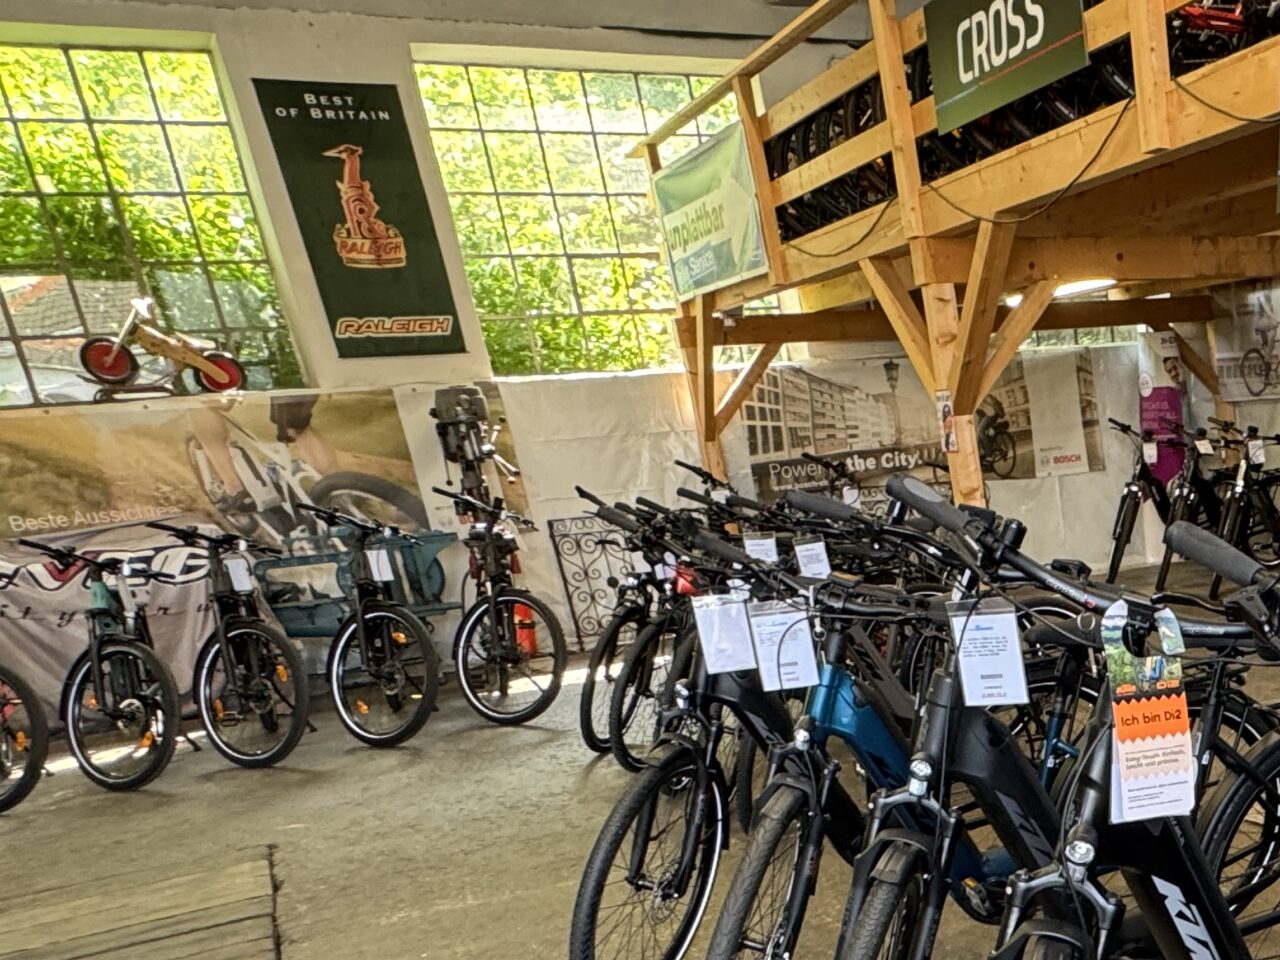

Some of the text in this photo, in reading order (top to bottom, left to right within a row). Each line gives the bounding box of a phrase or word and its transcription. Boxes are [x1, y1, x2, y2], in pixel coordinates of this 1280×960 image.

[955, 0, 1045, 85] CROSS
[303, 93, 354, 106] BEST
[275, 107, 390, 121] OF BRITAIN
[339, 239, 403, 256] RALEIGH
[338, 317, 451, 337] RALEIGH
[846, 455, 876, 471] the
[1053, 453, 1082, 465] BOSCH
[8, 512, 70, 532] Beste
[1120, 709, 1183, 728] Ich bin Di2
